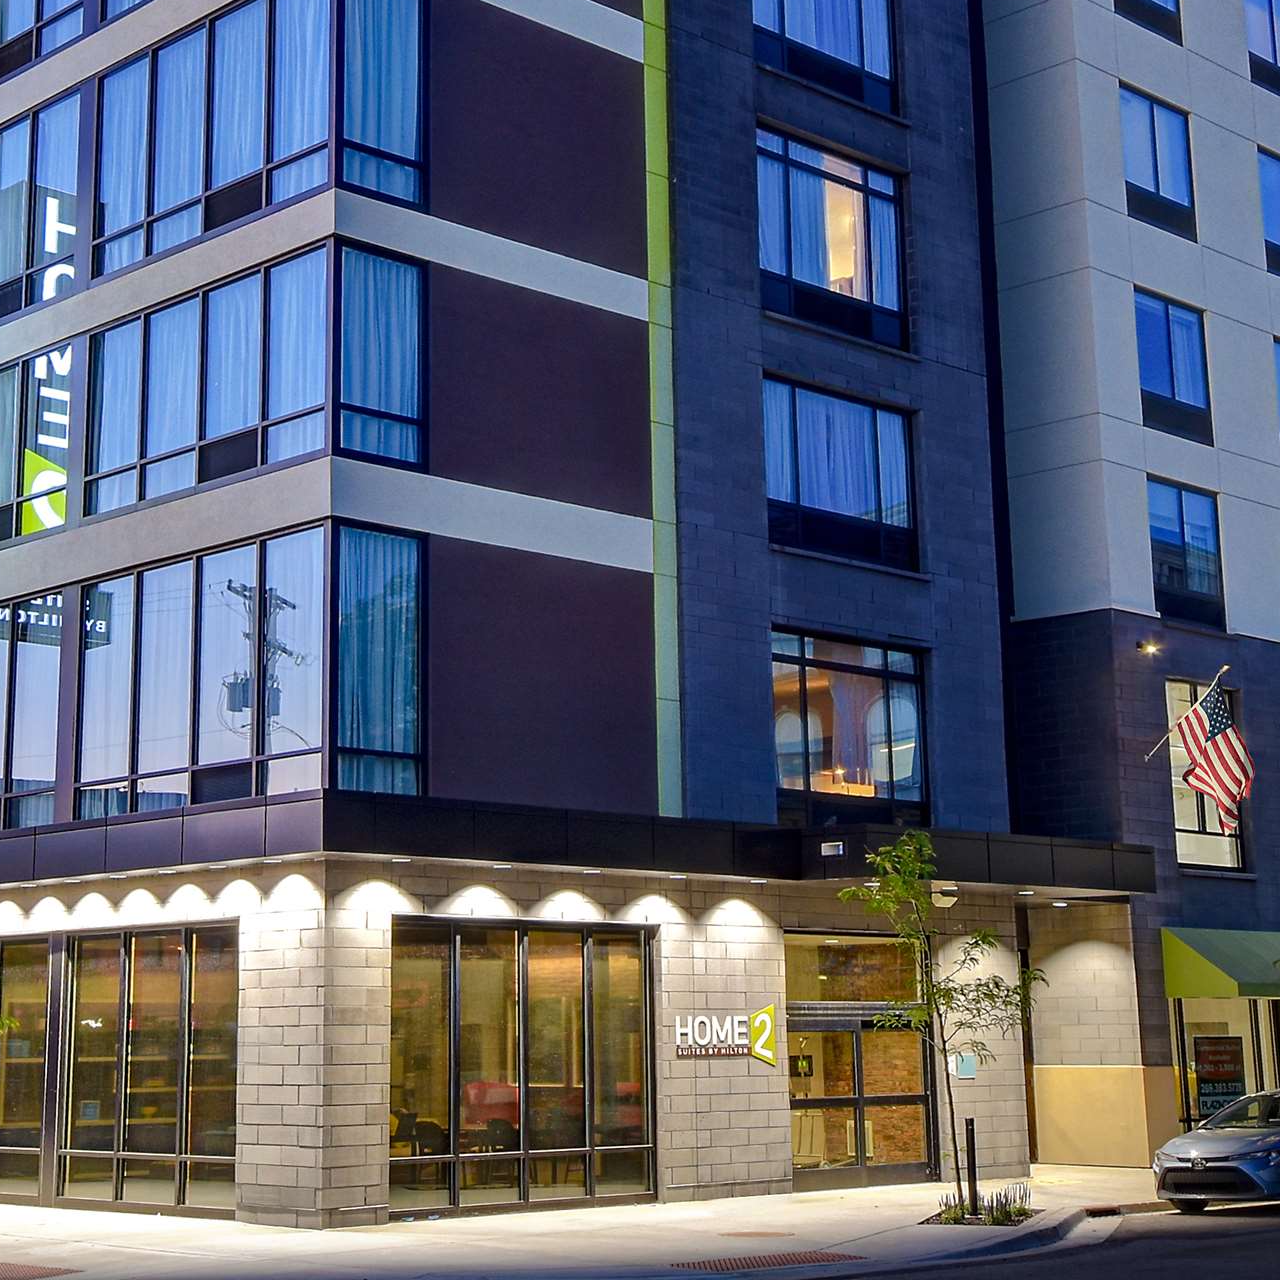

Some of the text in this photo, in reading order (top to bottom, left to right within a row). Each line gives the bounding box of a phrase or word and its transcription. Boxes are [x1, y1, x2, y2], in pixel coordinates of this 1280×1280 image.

[675, 1013, 773, 1059] HOME 2
[678, 1047, 748, 1056] SUITES BY HILTON
